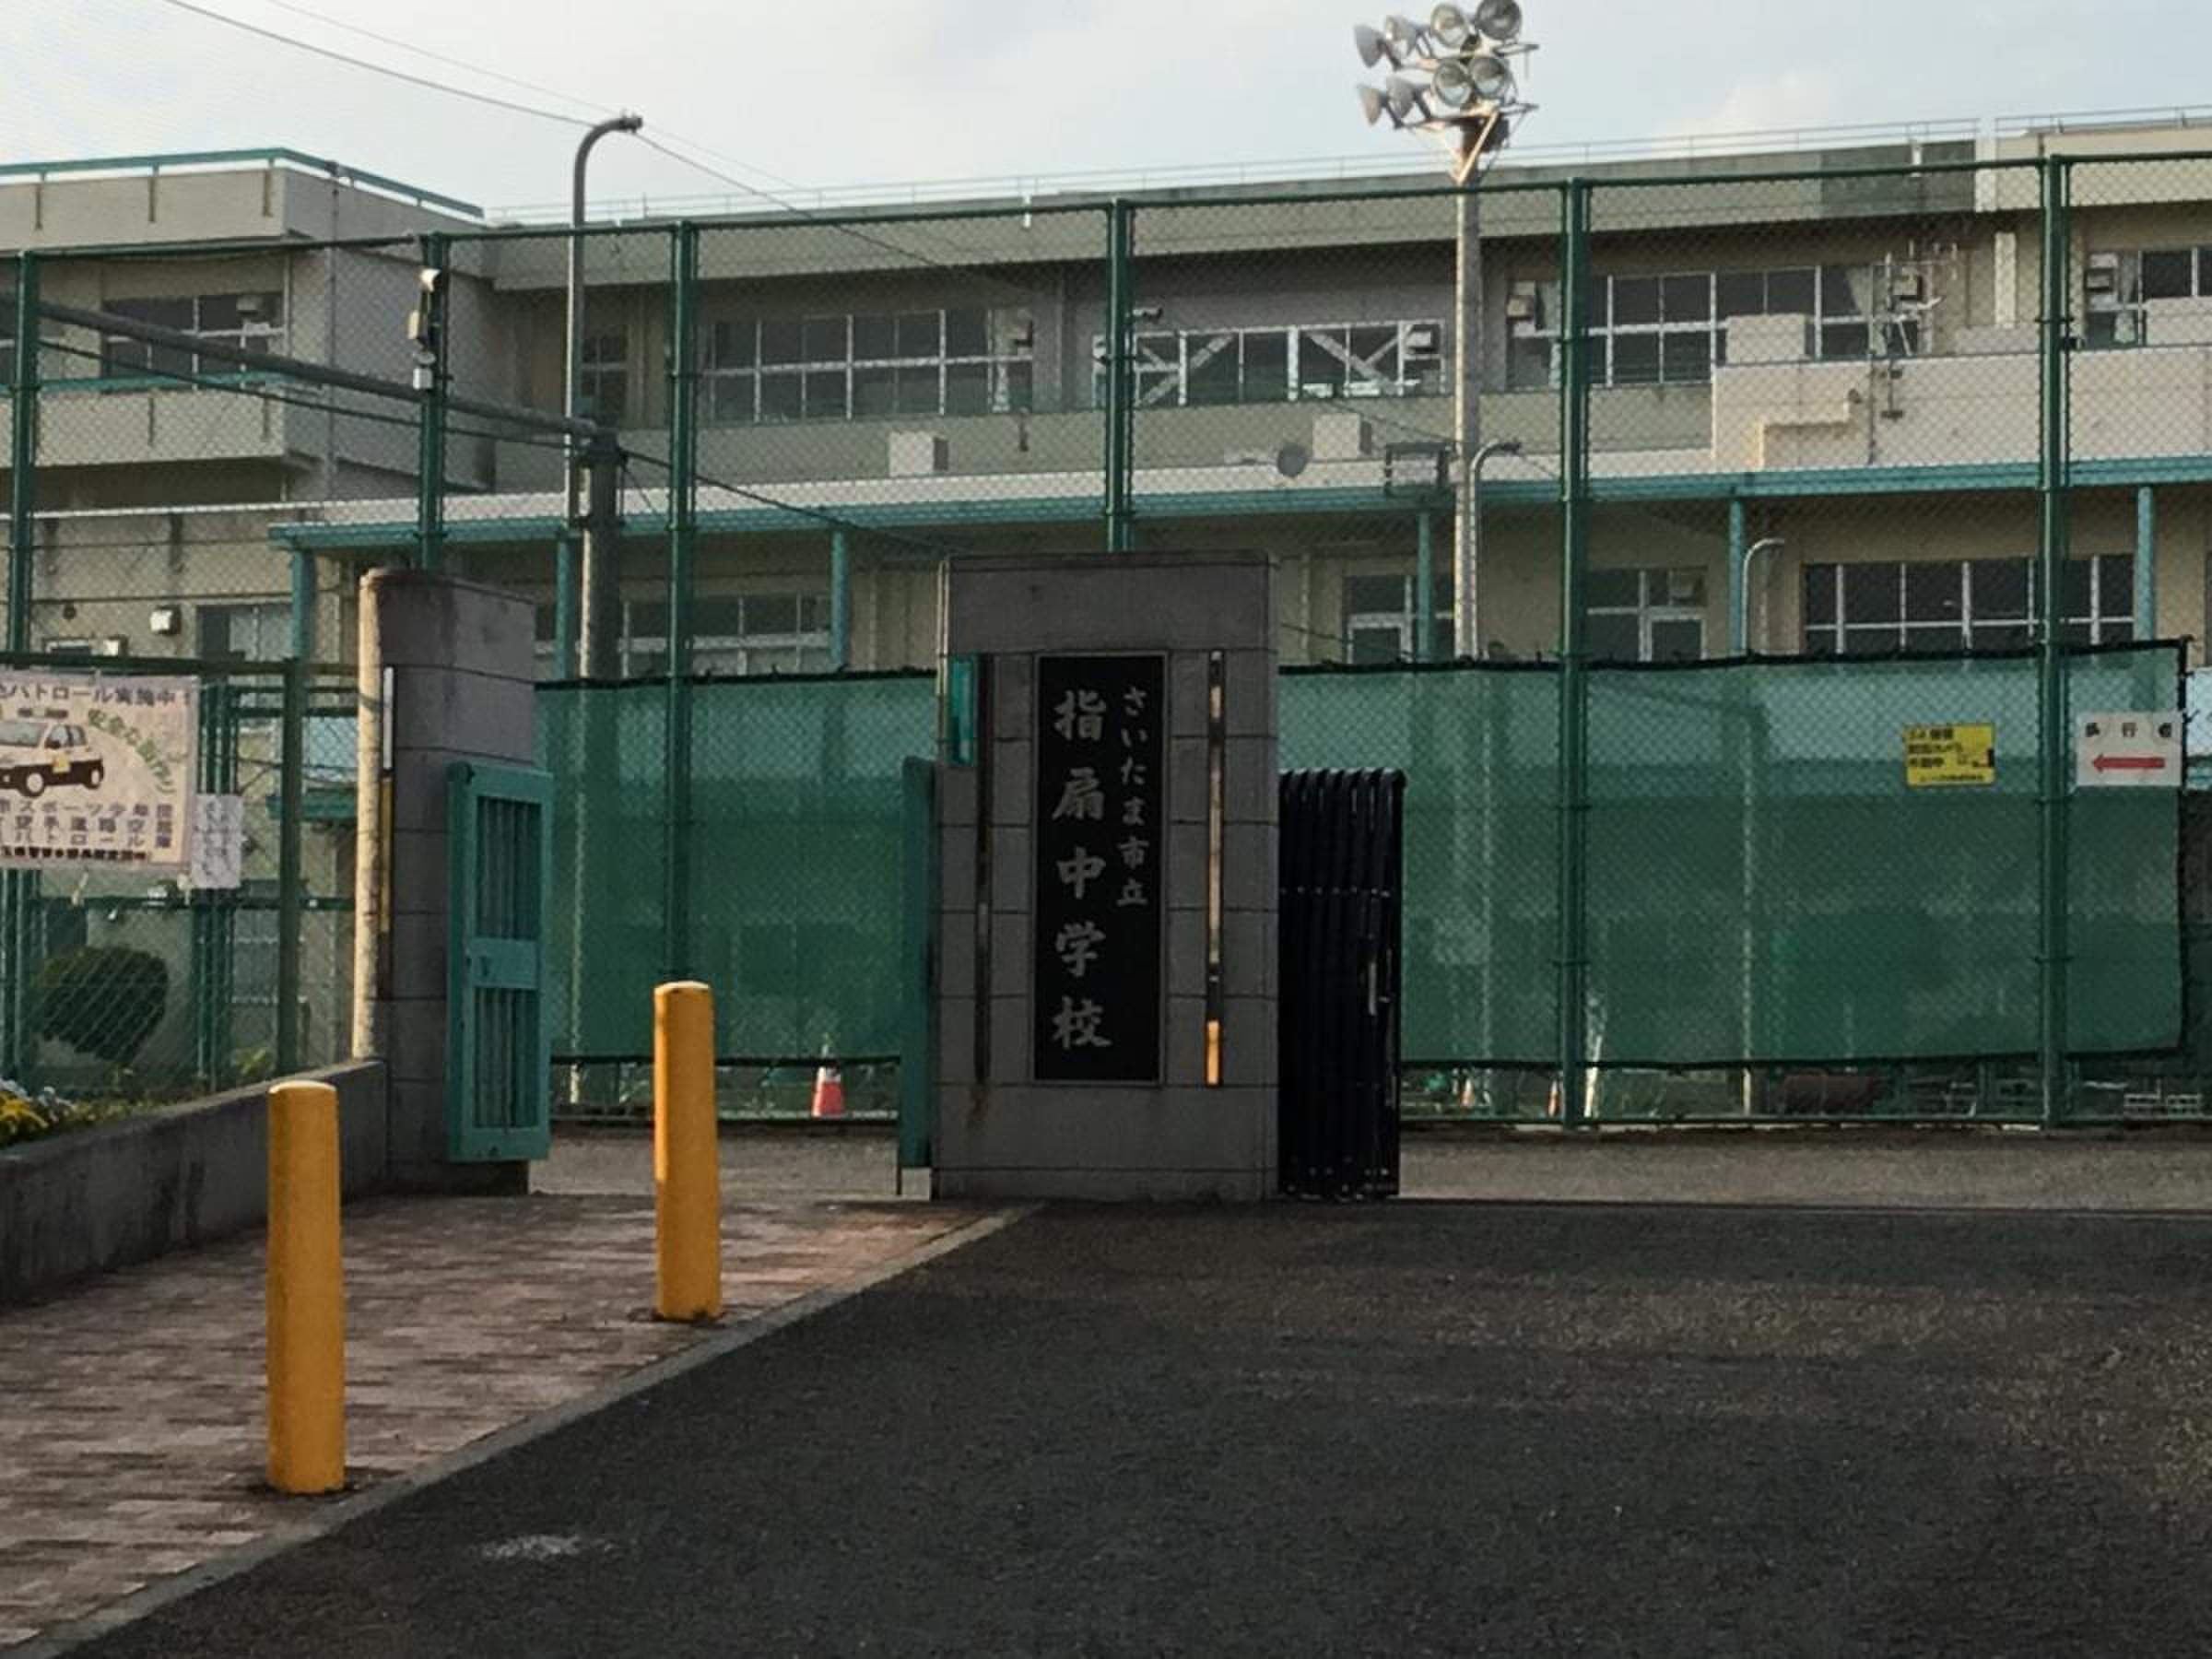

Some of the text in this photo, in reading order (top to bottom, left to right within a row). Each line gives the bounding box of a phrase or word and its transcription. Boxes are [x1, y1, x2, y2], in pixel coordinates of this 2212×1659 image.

[1052, 689, 1112, 1049] 指扇中学校
[1117, 687, 1149, 907] さいたま市立
